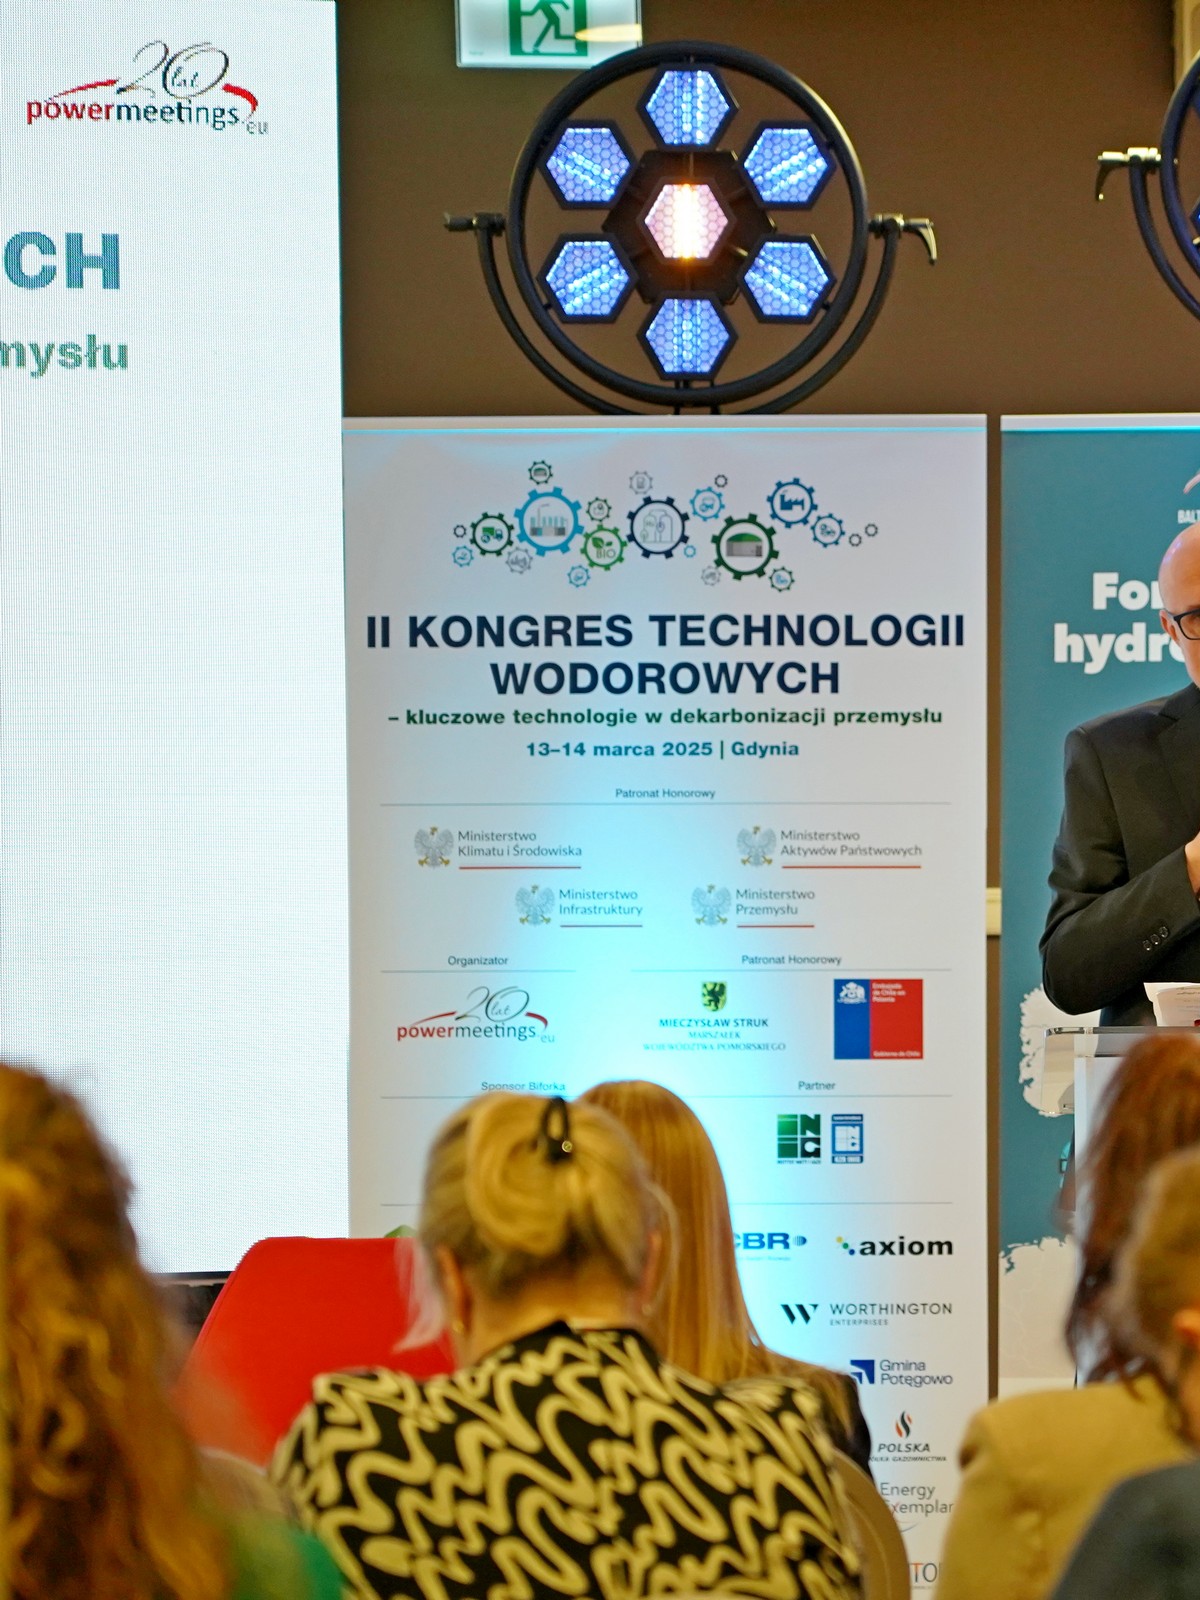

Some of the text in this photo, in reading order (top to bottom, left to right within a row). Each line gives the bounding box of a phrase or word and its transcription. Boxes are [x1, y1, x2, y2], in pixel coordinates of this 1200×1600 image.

[3, 231, 120, 290] CH
[366, 614, 965, 648] II KONGRES TECHNOLOGII
[489, 661, 840, 695] WODOROWYCH
[406, 708, 506, 725] kluczowe
[513, 708, 638, 727] technologie
[645, 712, 663, 724] w
[670, 707, 826, 726] dekarbonizacji
[833, 707, 943, 727] przemysłu
[593, 744, 655, 756] marca
[662, 741, 713, 756] 2025
[731, 741, 800, 759] Gdynia
[615, 787, 716, 800] Patronat Honorowy
[458, 830, 537, 843] Ministerstwo
[780, 829, 860, 842] Ministerstwo
[458, 846, 504, 858] Klimatu
[512, 843, 583, 857] Środowiska
[780, 843, 923, 859] Aktywów Państwowych
[559, 889, 638, 901] Ministerstwo
[736, 888, 816, 901] Ministerstwo
[559, 903, 643, 916] Infrastruktury
[736, 904, 799, 917] Przemysłu
[447, 955, 509, 967] Organizator
[741, 954, 842, 966] Patronat Honorowy
[455, 985, 530, 1023] 20
[658, 1018, 769, 1028] MIECZYSŁAW STRUK
[481, 1082, 566, 1094] Sponsor Biforka
[798, 1080, 836, 1091] Partner
[859, 1236, 954, 1256] axiom
[829, 1303, 953, 1316] WORTHINGTON
[829, 1319, 889, 1327] ENTERPRISES
[879, 1359, 926, 1372] Gmina
[880, 1372, 953, 1388] Potęgowo
[877, 1443, 932, 1453] POLSKA
[880, 1482, 936, 1500] Energy
